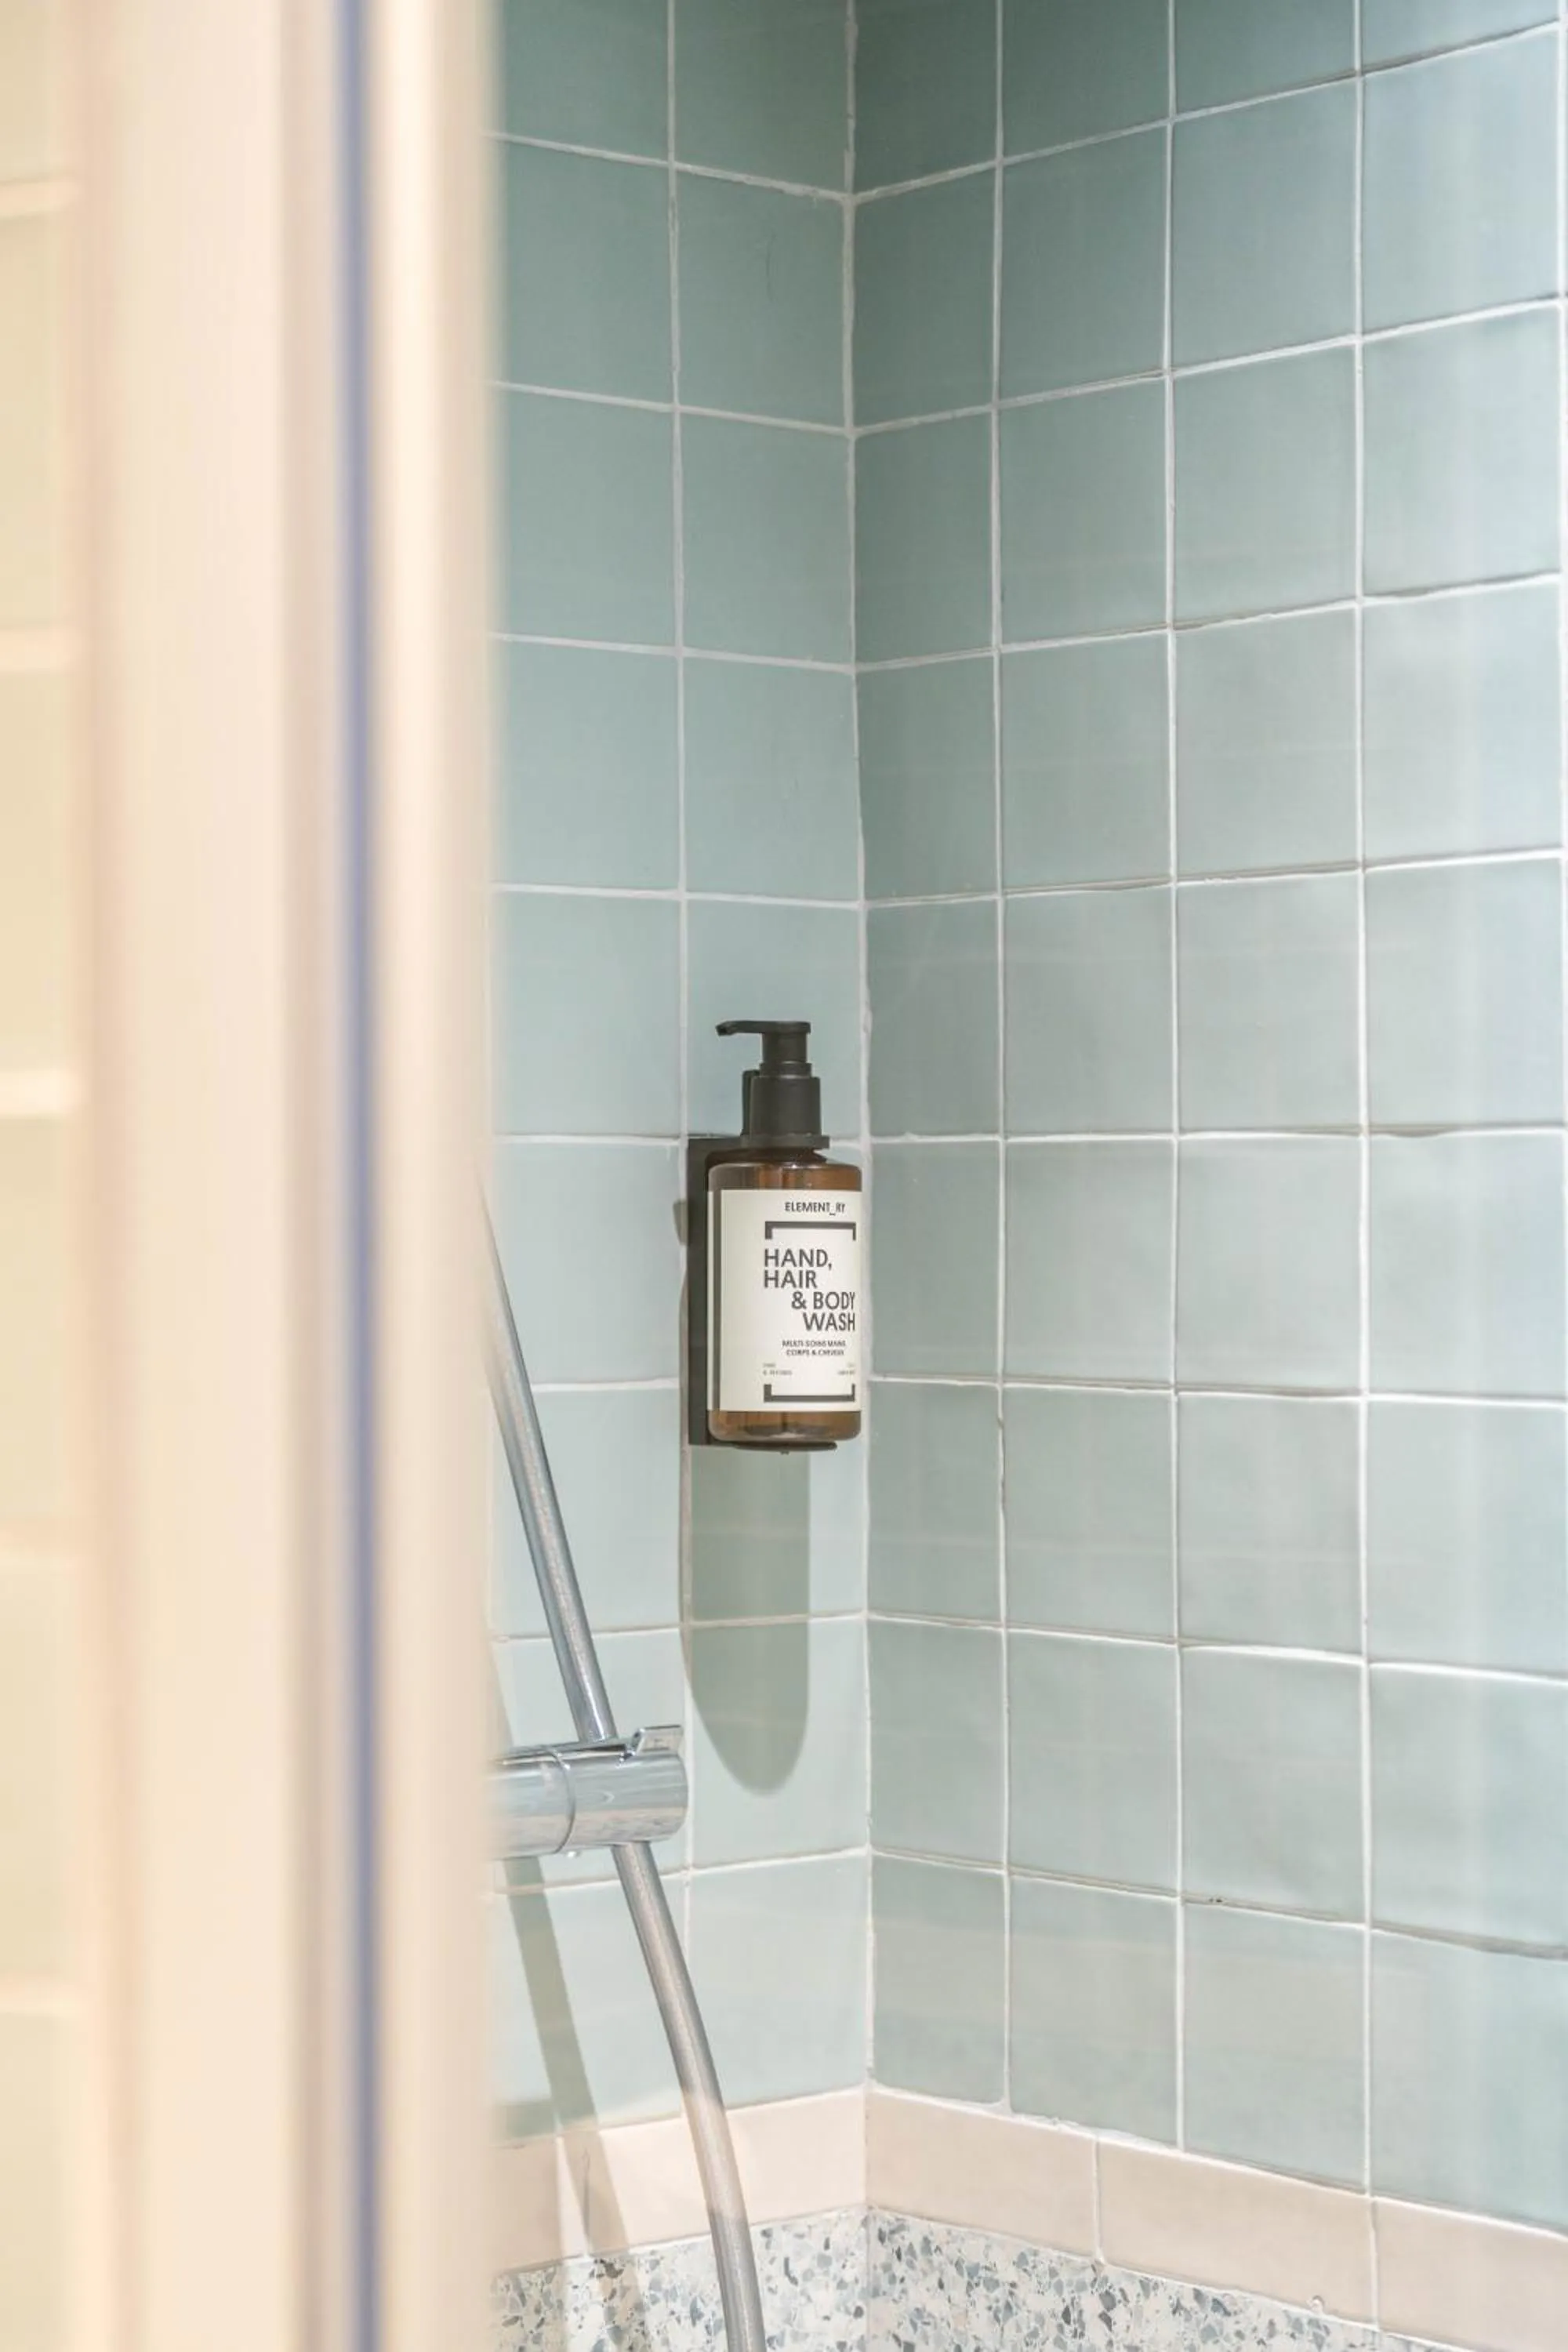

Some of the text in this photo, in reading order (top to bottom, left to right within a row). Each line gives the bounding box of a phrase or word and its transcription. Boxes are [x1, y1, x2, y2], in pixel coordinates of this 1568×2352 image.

[764, 1248, 833, 1270] HAND,
[764, 1269, 818, 1289] HAIR
[791, 1291, 855, 1310] & BODY
[803, 1312, 855, 1331] WASH
